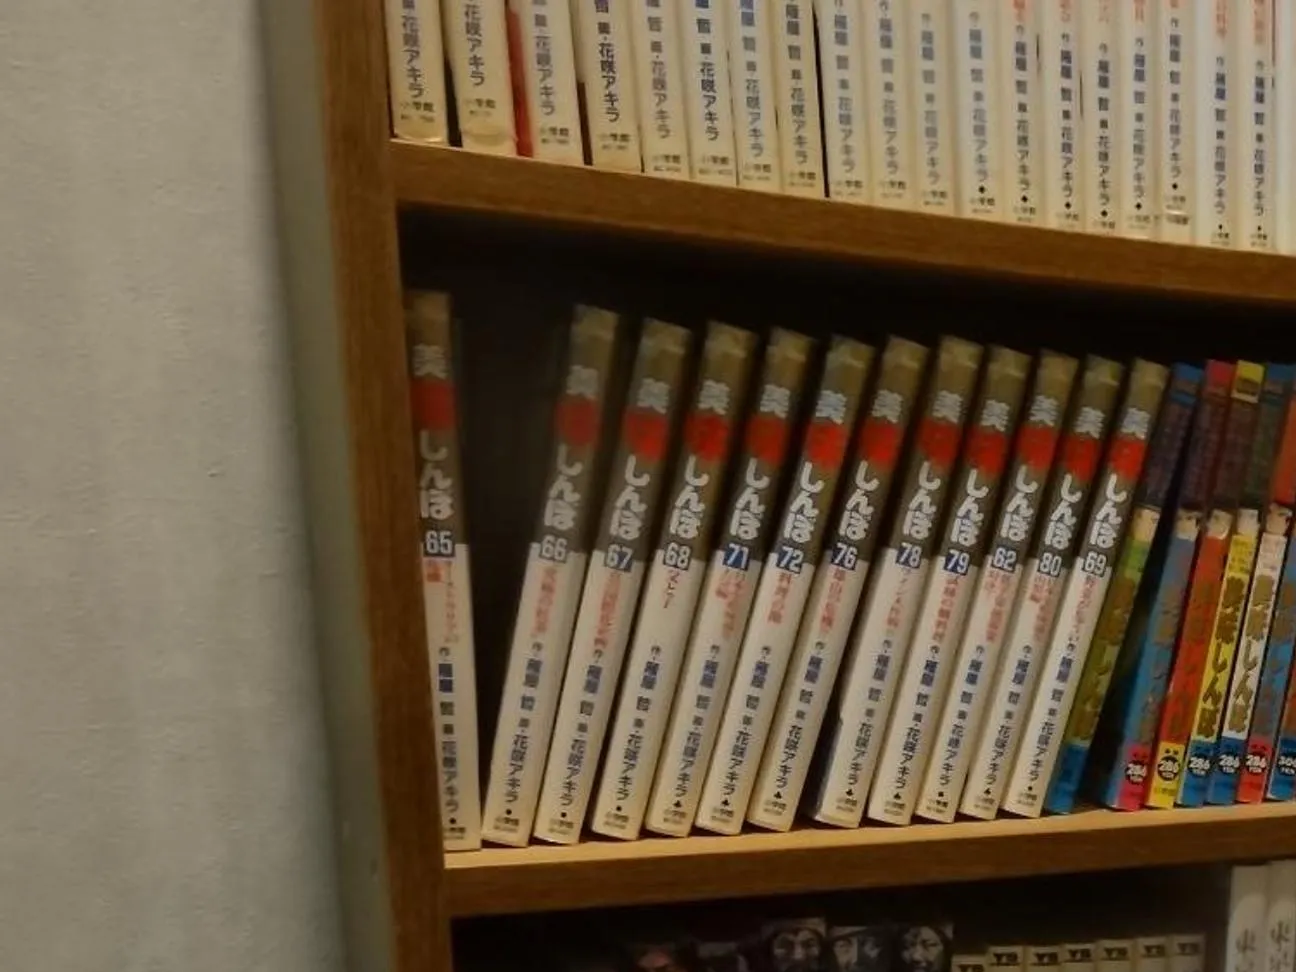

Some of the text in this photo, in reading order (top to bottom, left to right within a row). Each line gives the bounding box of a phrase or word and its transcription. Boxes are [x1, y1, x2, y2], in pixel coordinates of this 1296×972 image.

[413, 344, 453, 520] 美しんぼ
[544, 365, 598, 530] 美しんぼ
[610, 378, 670, 540] 美しんぼ
[670, 379, 730, 539] 美しんぼ
[730, 384, 790, 540] 美しんぼ
[784, 390, 846, 543] 美しんぼ
[839, 389, 902, 541] 美しんぼ
[903, 390, 963, 540] 美しんぼ
[952, 400, 1009, 546] 美しんぼ
[424, 531, 453, 555] 65
[540, 536, 567, 560] 66
[664, 543, 690, 569] 68
[724, 543, 748, 569] 71
[832, 543, 857, 569] 76
[897, 543, 921, 567] 78
[605, 544, 632, 570] 67
[777, 547, 803, 572] 72
[945, 550, 969, 574] 79
[1039, 554, 1062, 575] 80
